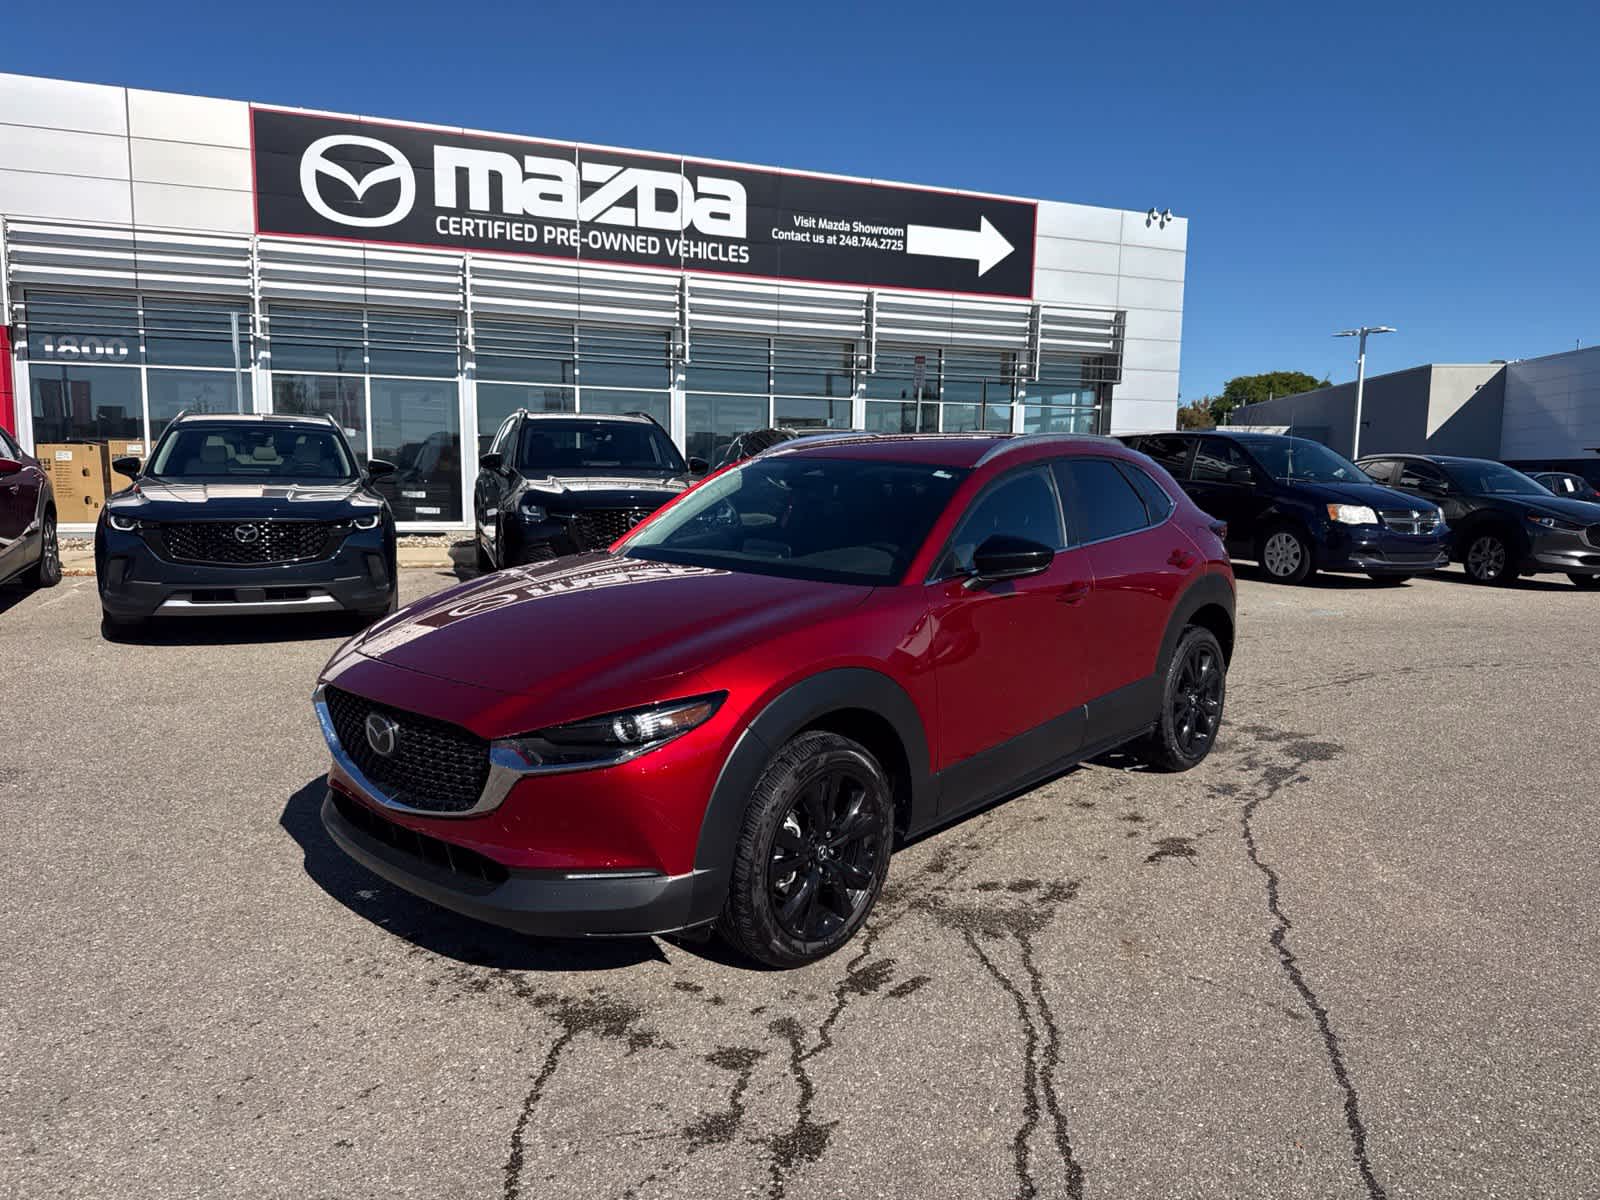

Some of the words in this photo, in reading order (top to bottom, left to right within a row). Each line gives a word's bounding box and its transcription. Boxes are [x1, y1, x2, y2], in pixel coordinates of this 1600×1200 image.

[793, 215, 816, 228] Visit
[818, 217, 850, 231] Mazda
[852, 221, 904, 237] Showroom
[435, 215, 538, 243] CERTIFIED
[543, 225, 661, 255] PRE-OWNED
[665, 237, 750, 264] VEHICLES
[771, 228, 810, 242] Contact
[812, 234, 825, 244] us
[826, 234, 837, 245] at
[839, 234, 904, 251] 248.744.2725
